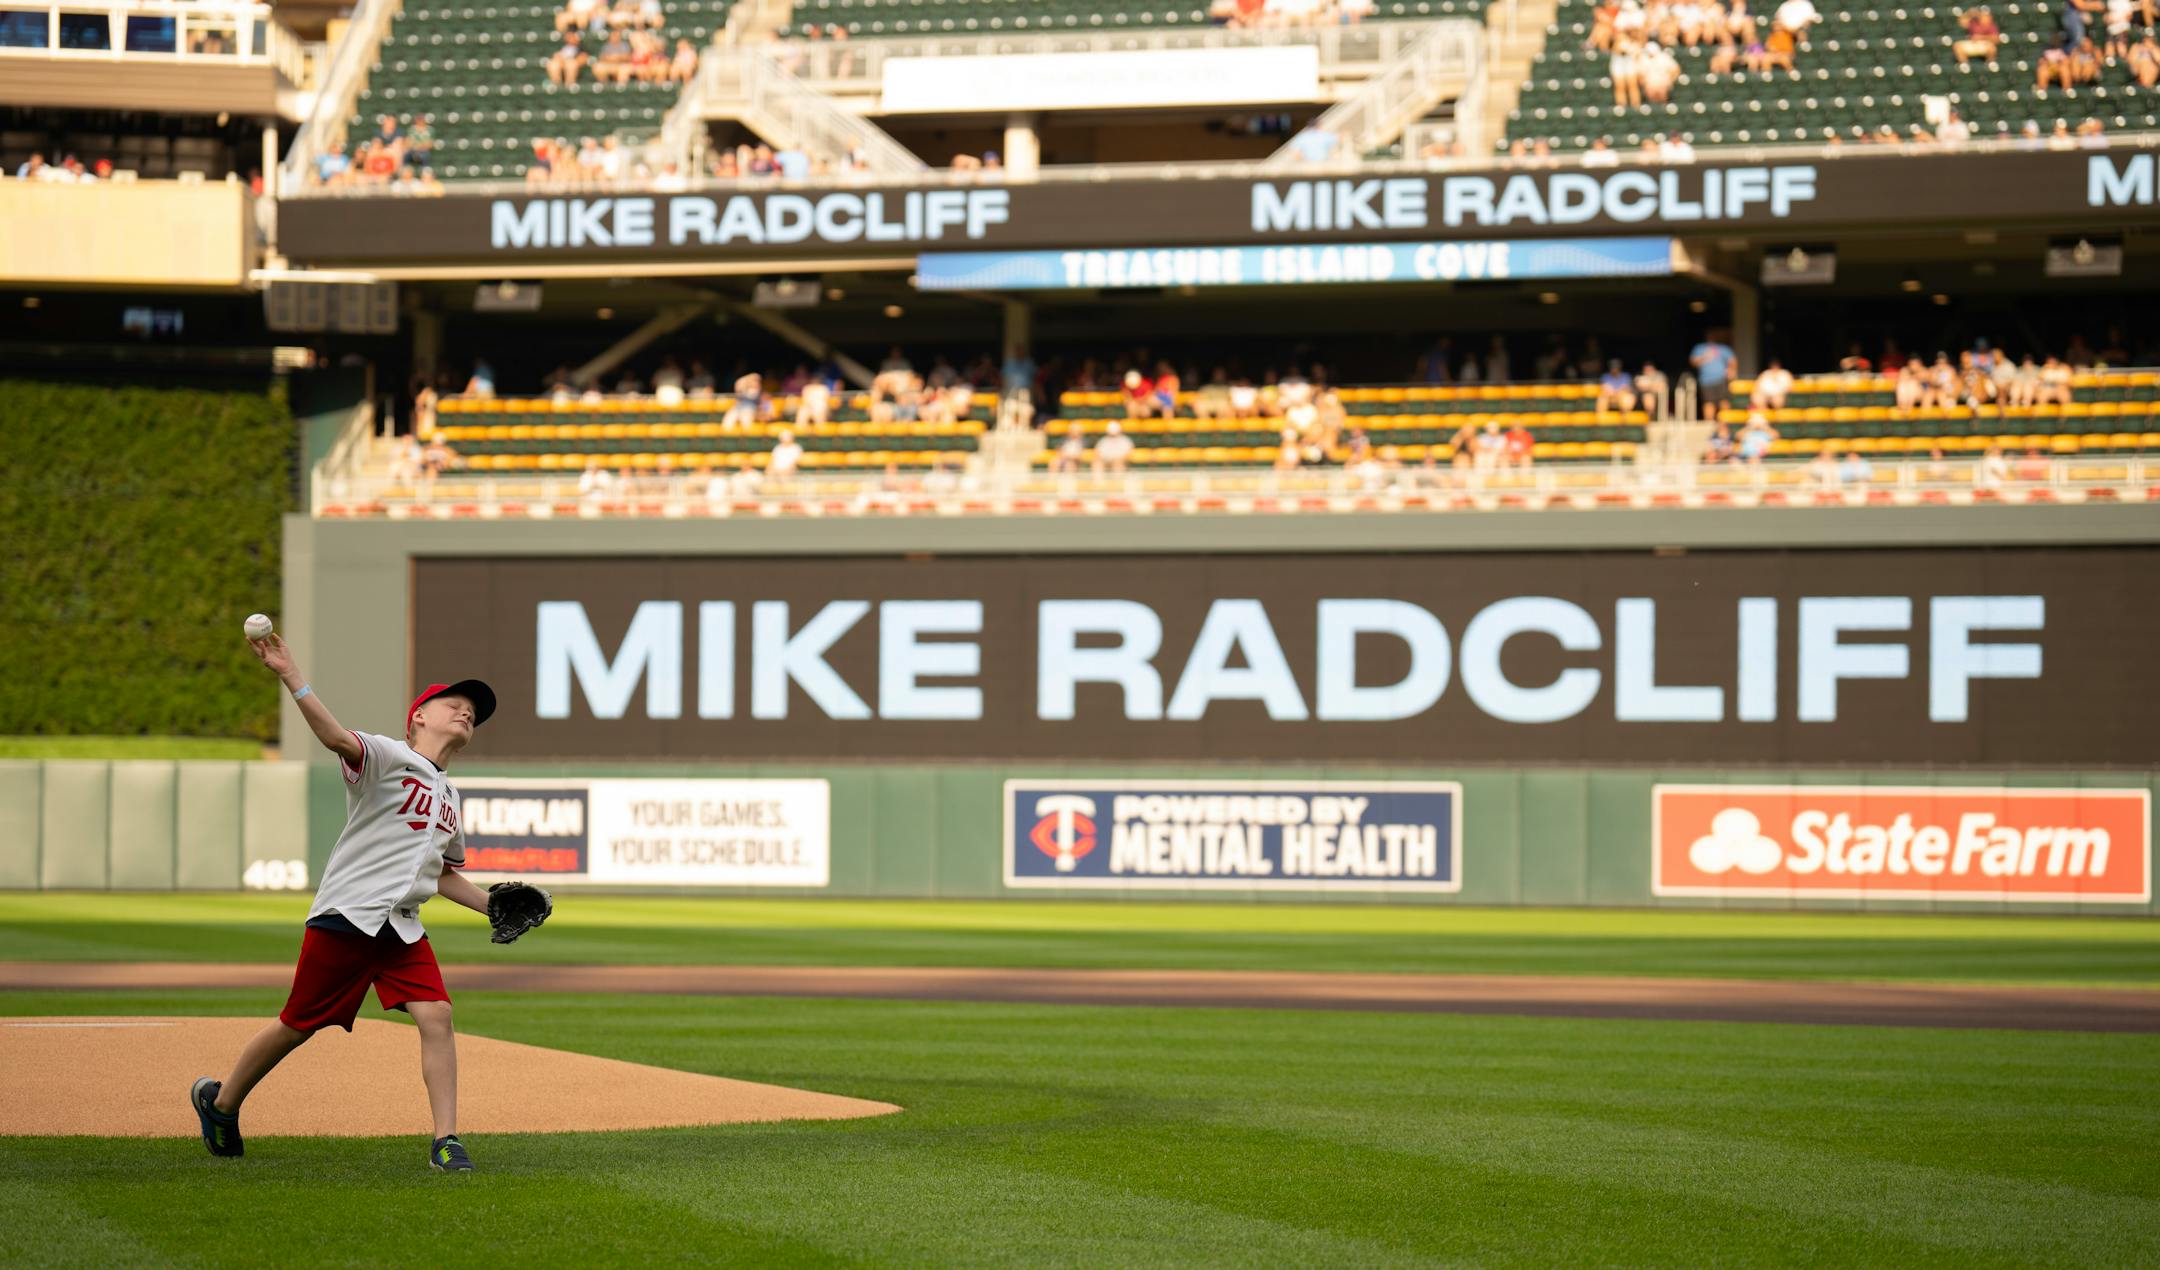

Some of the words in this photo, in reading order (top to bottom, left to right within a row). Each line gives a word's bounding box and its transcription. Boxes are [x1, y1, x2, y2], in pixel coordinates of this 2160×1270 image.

[1251, 178, 1428, 232] MIKE
[1443, 166, 1817, 227] RADCLIFF
[2088, 153, 2160, 207] M
[491, 198, 655, 248] MIKE
[668, 190, 1009, 244] RADCLIFF
[1062, 250, 1244, 287] TREASURE
[1262, 245, 1396, 283] ISLAND
[1413, 242, 1511, 280] COVE
[536, 600, 984, 720] MIKE
[1037, 596, 2045, 723] RADCLIFF
[629, 800, 693, 827] YOUR
[699, 799, 789, 828] GAMES.
[1112, 795, 1308, 825] POWERED
[1311, 797, 1370, 825] BY
[609, 838, 673, 866] YOUR
[679, 837, 815, 867] SCHEDULE.
[1109, 822, 1273, 875] MENTAL
[1282, 824, 1438, 877] HEALTH
[242, 859, 309, 891] 403
